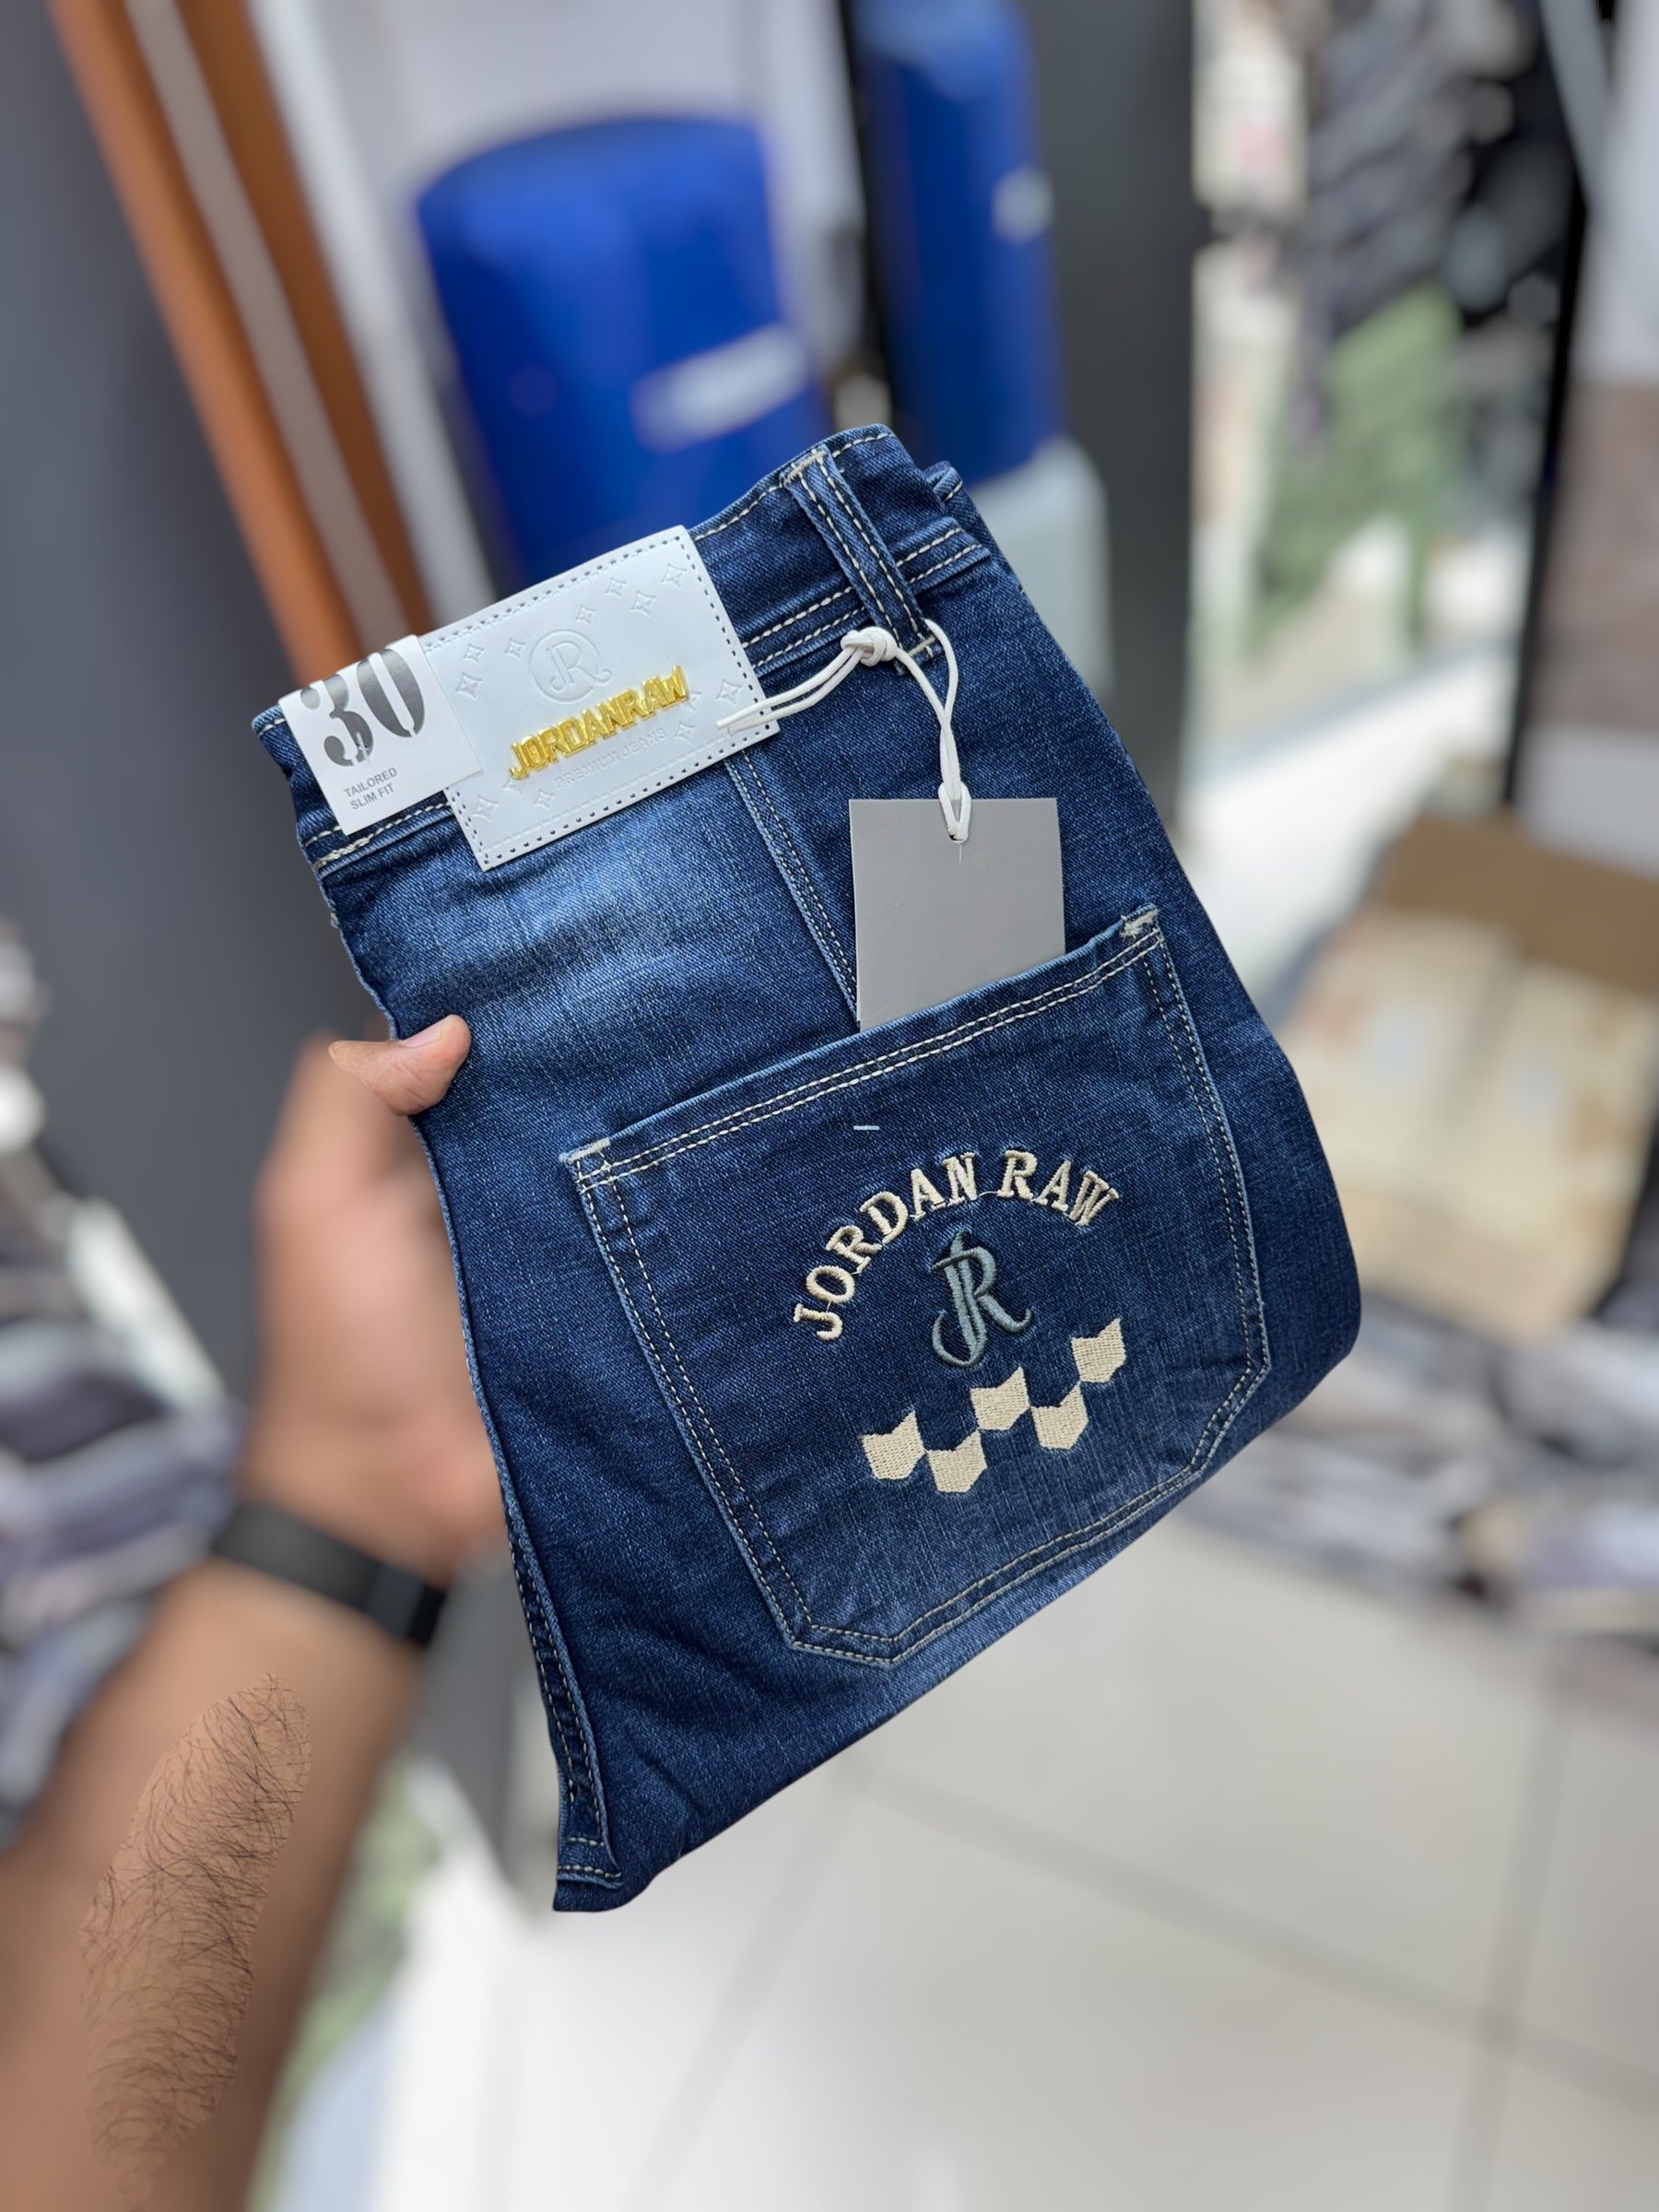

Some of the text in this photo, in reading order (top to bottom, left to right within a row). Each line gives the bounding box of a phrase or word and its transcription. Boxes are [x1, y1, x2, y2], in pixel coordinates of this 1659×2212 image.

[300, 648, 425, 767] 30
[508, 664, 689, 781] JORDANRAW
[344, 767, 397, 798] TAILORED
[350, 782, 394, 810] SLIM FIT
[794, 1149, 1119, 1342] JORDAN RAW
